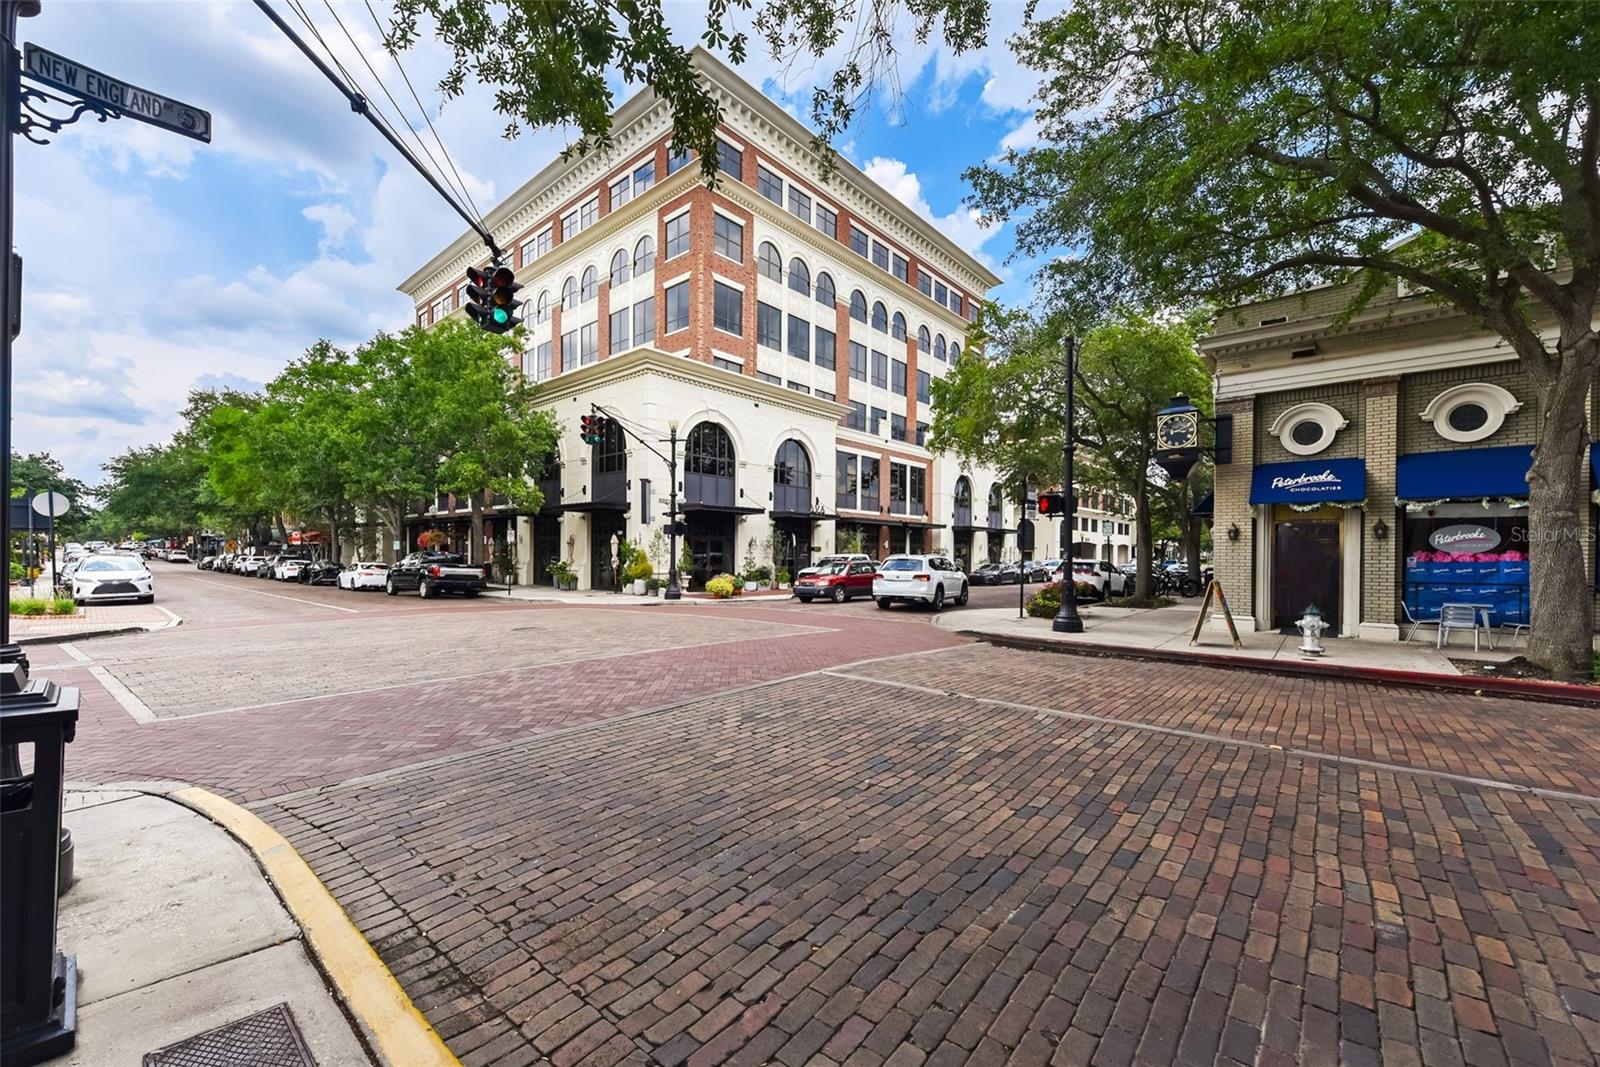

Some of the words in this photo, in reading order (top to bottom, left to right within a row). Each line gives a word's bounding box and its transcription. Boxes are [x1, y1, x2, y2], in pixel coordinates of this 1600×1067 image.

[39, 53, 78, 86] NEW
[86, 74, 162, 117] ENGLAND
[1271, 469, 1339, 489] Peterbrooke
[1434, 528, 1486, 545] Peterbrooke
